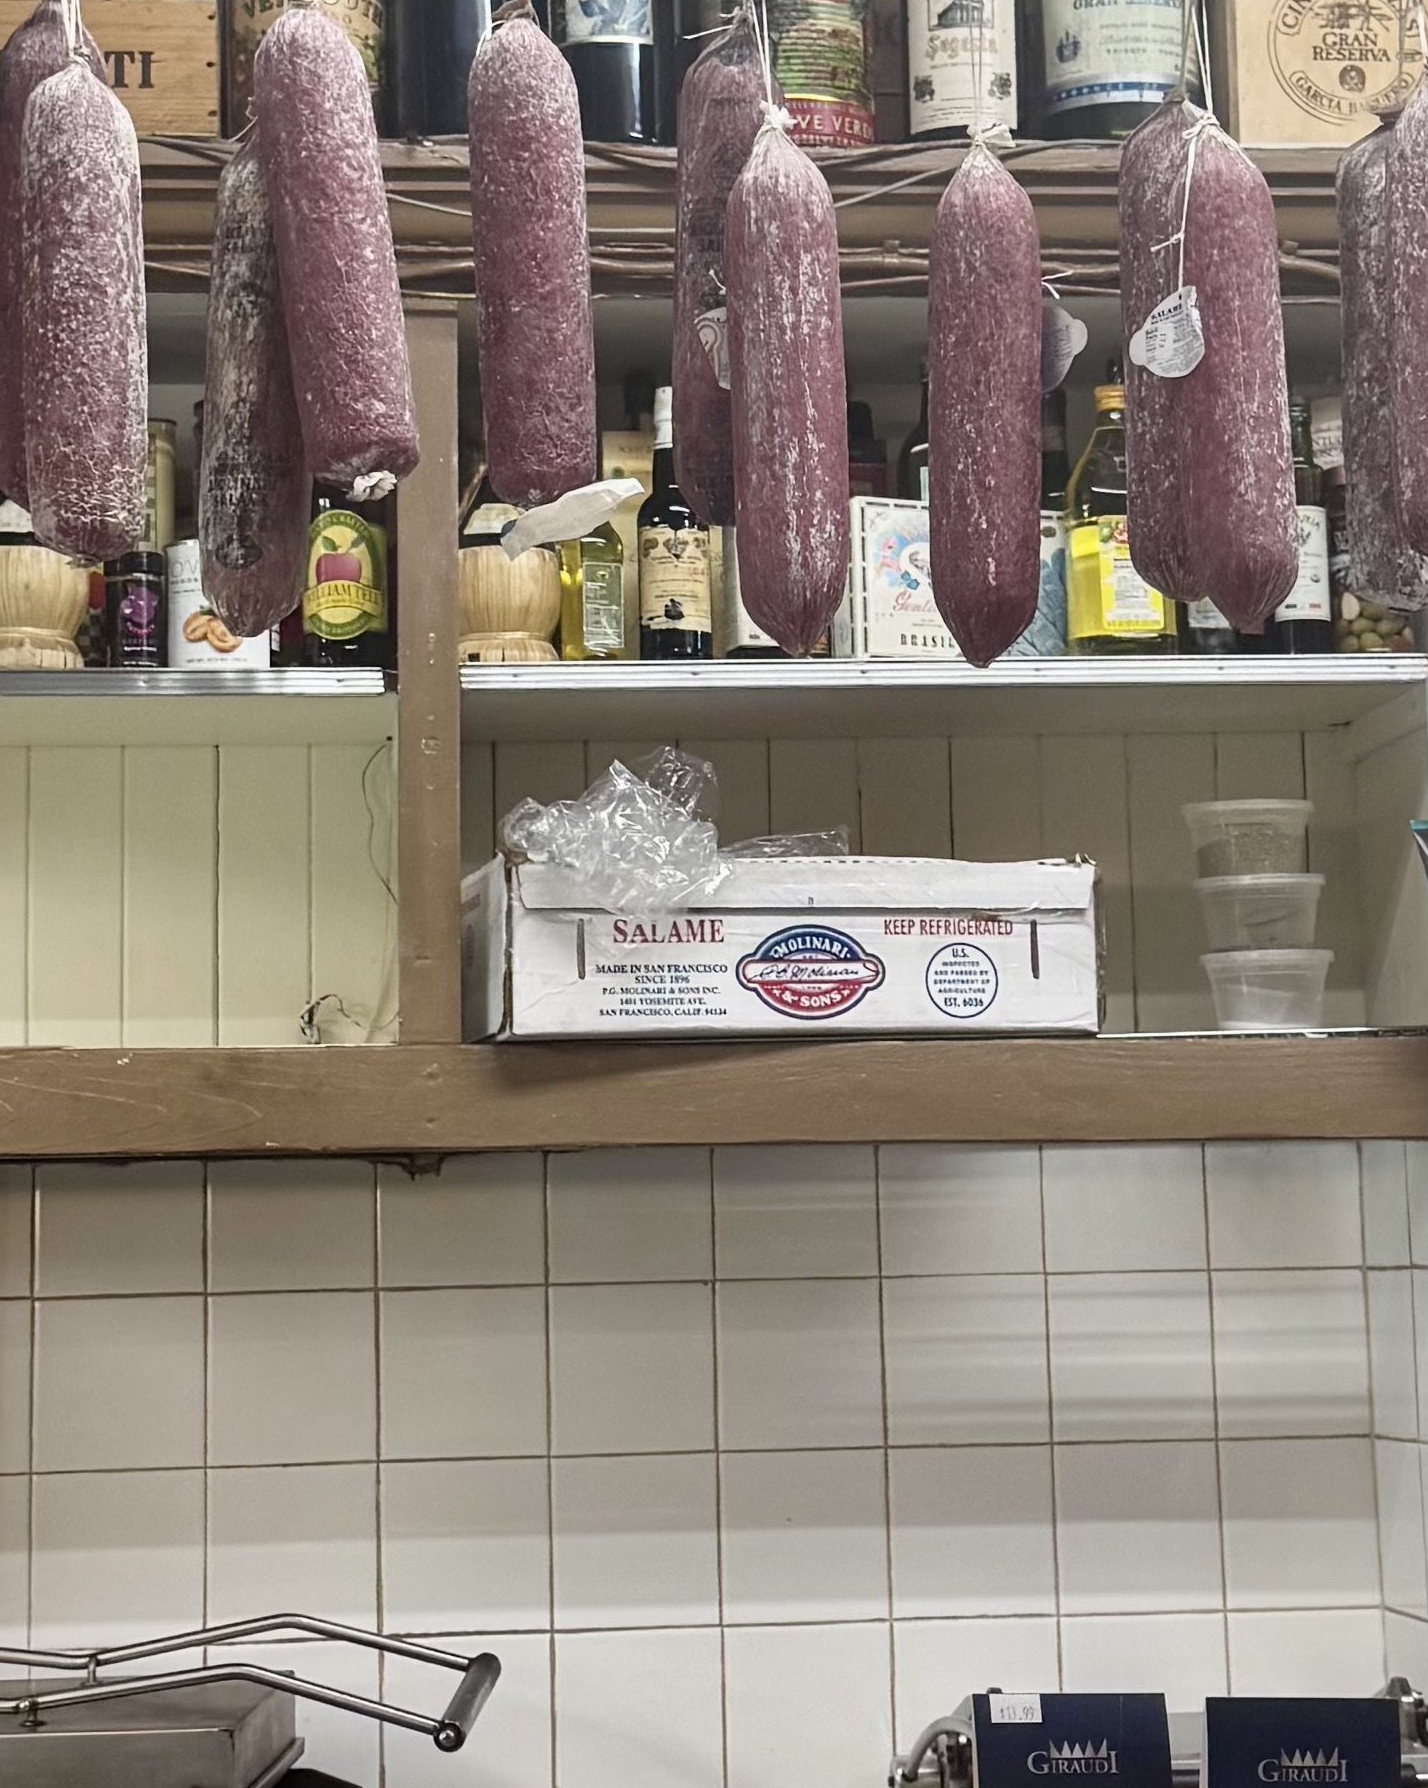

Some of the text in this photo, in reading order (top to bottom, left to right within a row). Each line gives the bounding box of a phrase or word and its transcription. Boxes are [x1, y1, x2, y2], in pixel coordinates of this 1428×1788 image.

[1321, 32, 1378, 50] GRAN
[1313, 46, 1392, 62] RESERVA
[613, 919, 724, 943] SALAME
[884, 918, 1013, 935] KEEP REFRIGERATED
[772, 935, 848, 958] MOLINARI
[952, 948, 970, 958] U.S.
[595, 964, 728, 973] MADE IN SAN FRANCISCO
[635, 975, 690, 984] SINCE 1896
[782, 990, 842, 1008] & SONS
[944, 998, 961, 1008] EST.
[1026, 1751, 1120, 1774] GIRAUDI
